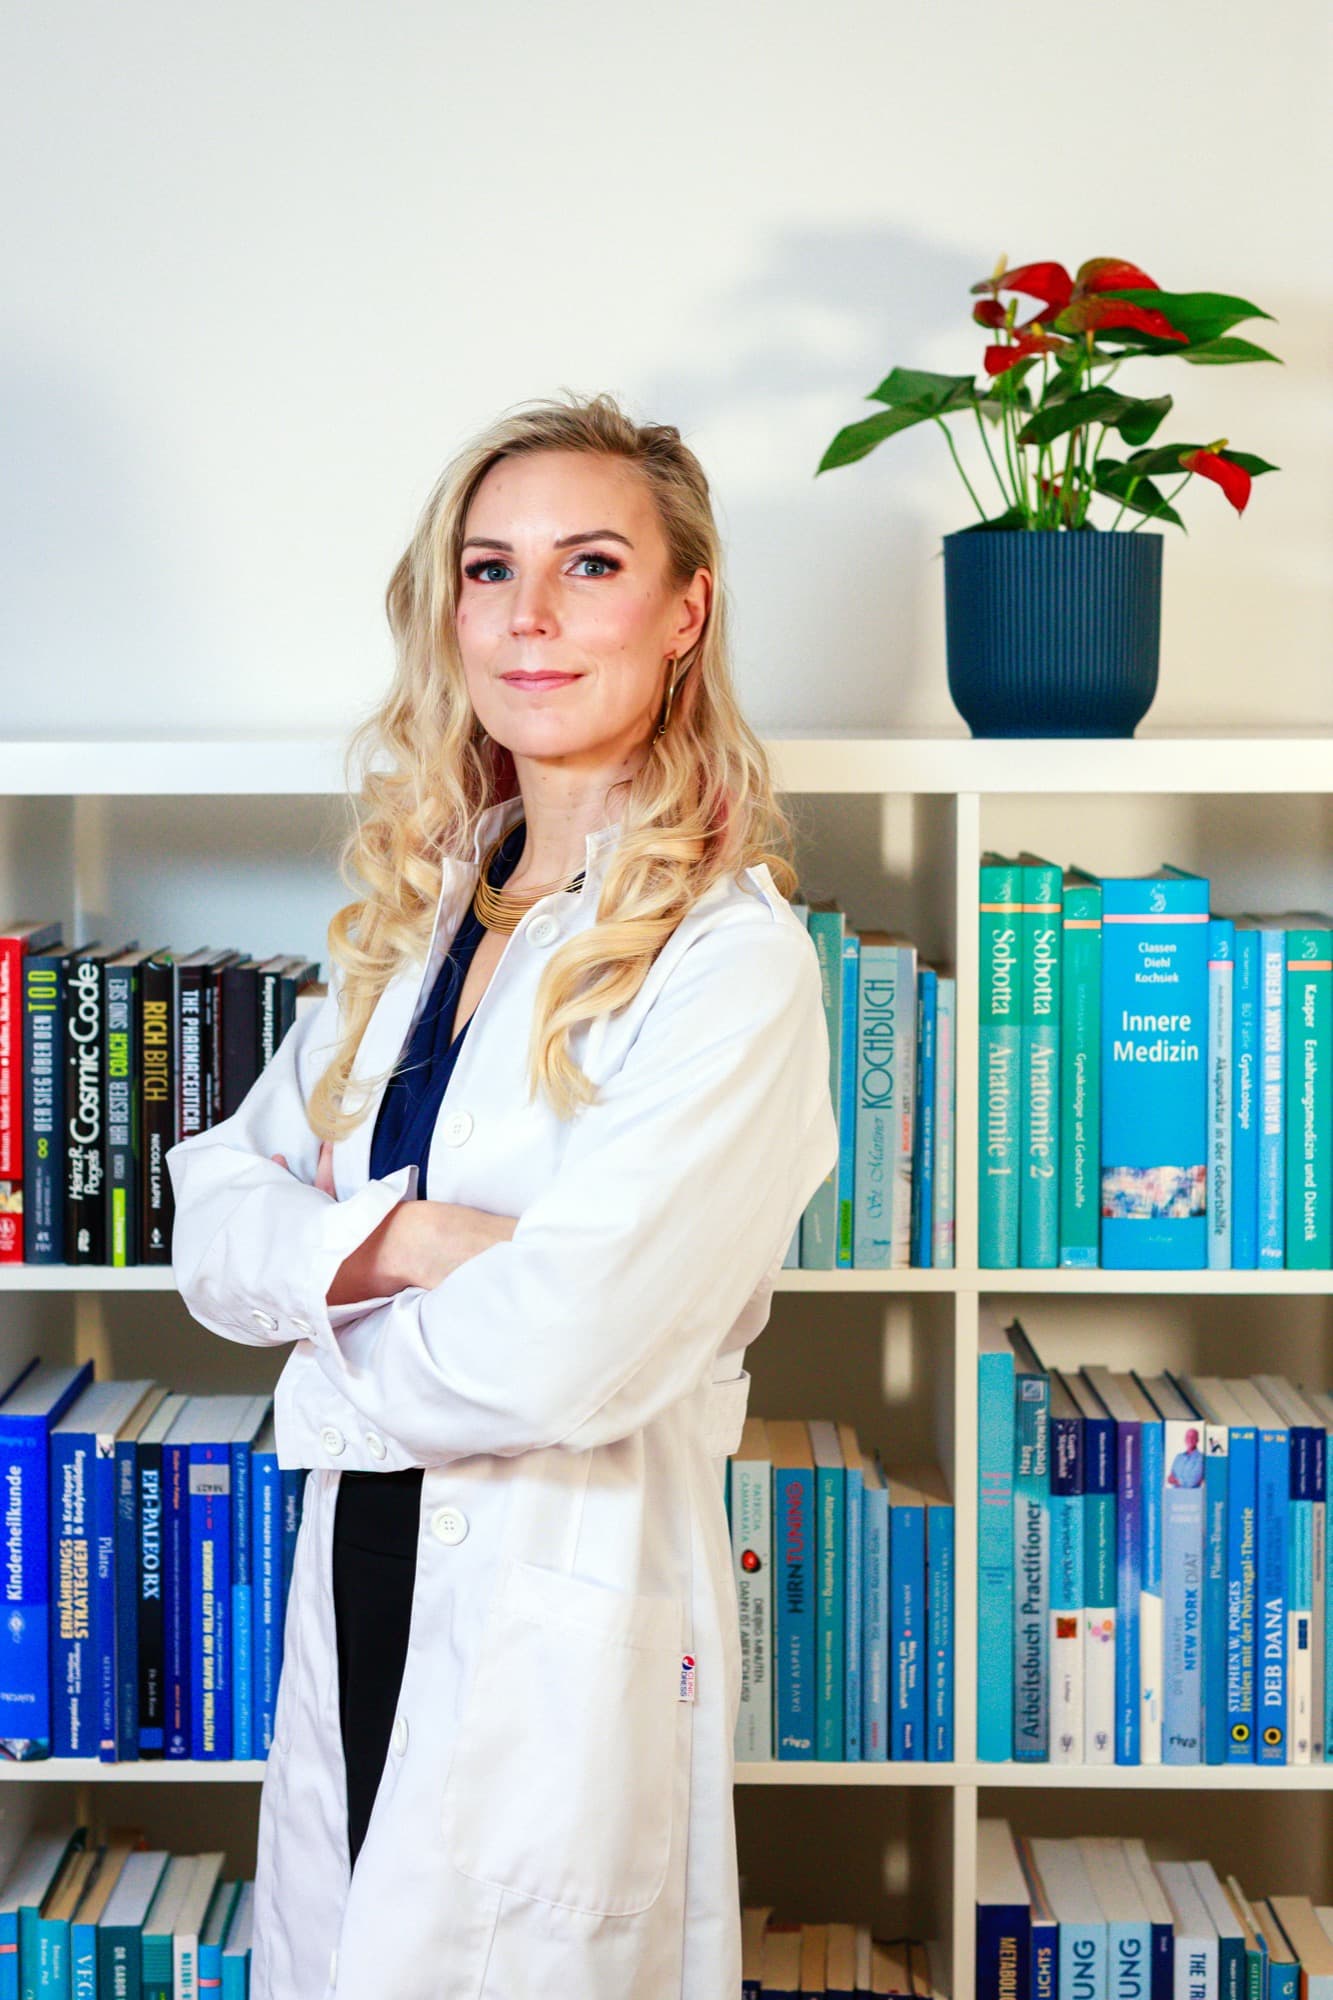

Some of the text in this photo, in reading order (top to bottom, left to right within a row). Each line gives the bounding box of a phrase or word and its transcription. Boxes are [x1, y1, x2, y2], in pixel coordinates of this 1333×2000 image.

[991, 929, 1016, 1015] Sobotta
[1033, 929, 1058, 1015] Sobotta
[1137, 941, 1177, 953] Classen
[1143, 956, 1171, 968] Diehl
[1134, 972, 1179, 984] Kochsiek
[1265, 952, 1282, 1006] WERDEN
[33, 1016, 53, 1040] DEN
[861, 979, 895, 1109] KOCHBUCH
[1121, 1011, 1191, 1032] Innere
[1265, 1008, 1282, 1053] KRANK
[31, 1043, 53, 1075] ÜBER
[68, 963, 100, 1144] Cosmic Code
[108, 978, 129, 1145] IHR BESTER COACH SIND SIE!
[143, 1001, 168, 1101] RICH BITCH
[181, 989, 201, 1131] THE PHARMACEUTICAL
[1113, 1040, 1199, 1062] Medizin
[1265, 1055, 1282, 1082] WIR
[33, 1078, 53, 1106] SIEG
[987, 1043, 1014, 1176] Anatomie 1
[1029, 1043, 1056, 1178] Anatomie 2
[1073, 1053, 1087, 1118] Gynäkologie
[1213, 1056, 1228, 1124] Akupunktur
[1237, 1053, 1253, 1130] Gynäkologie
[1265, 1085, 1283, 1135] WARUM
[34, 1107, 53, 1132] DER
[1074, 1122, 1086, 1142] und
[1214, 1127, 1226, 1141] in
[1302, 984, 1319, 1242] Kasper Ernährungsmedizin und Diätetik
[67, 1145, 84, 1201] Heinz R.
[83, 1149, 103, 1196] Pagels
[150, 1133, 161, 1208] NICOLE LAPIN
[1072, 1144, 1086, 1208] Geburtshilfe
[1214, 1144, 1226, 1161] der
[1213, 1165, 1227, 1236] Geburtshilfe
[1019, 1446, 1034, 1476] Haag
[1034, 1408, 1047, 1476] Grochowiak
[62, 1464, 74, 1536] in Kraftsport
[73, 1450, 87, 1524] Bodybuilding
[741, 1471, 752, 1543] CAMMARATA
[752, 1483, 763, 1531] PATRICIA
[5, 1465, 23, 1601] Kinderheilkunde
[142, 1469, 160, 1600] EPI-PALEO RX
[825, 1496, 835, 1549] Attachment
[98, 1536, 114, 1579] Pilates
[822, 1551, 835, 1597] Parenting
[57, 1539, 74, 1639] ERNÄHRUNGS
[73, 1540, 89, 1639] STRATEGIEN
[201, 1593, 214, 1633] RELATED
[1184, 1589, 1197, 1631] YORK
[1228, 1580, 1241, 1631] PORGES
[202, 1634, 215, 1655] AND
[1020, 1501, 1042, 1739] Arbeitsbuch Practitioner
[1240, 1623, 1252, 1643] der
[1264, 1597, 1283, 1659] DANA
[790, 1635, 801, 1712] DAVE ASPREY
[1185, 1634, 1197, 1670] NEW
[1240, 1645, 1252, 1668] mit
[1228, 1652, 1241, 1713] STEPHEN
[1240, 1670, 1252, 1712] Heilen
[1264, 1665, 1282, 1707] DEB
[75, 1954, 94, 2000] VEG
[113, 1965, 127, 1996] GABOR
[1073, 1939, 1096, 2000] UNG
[1119, 1936, 1142, 2000] UNG
[1189, 1953, 1207, 2000] THE TR
